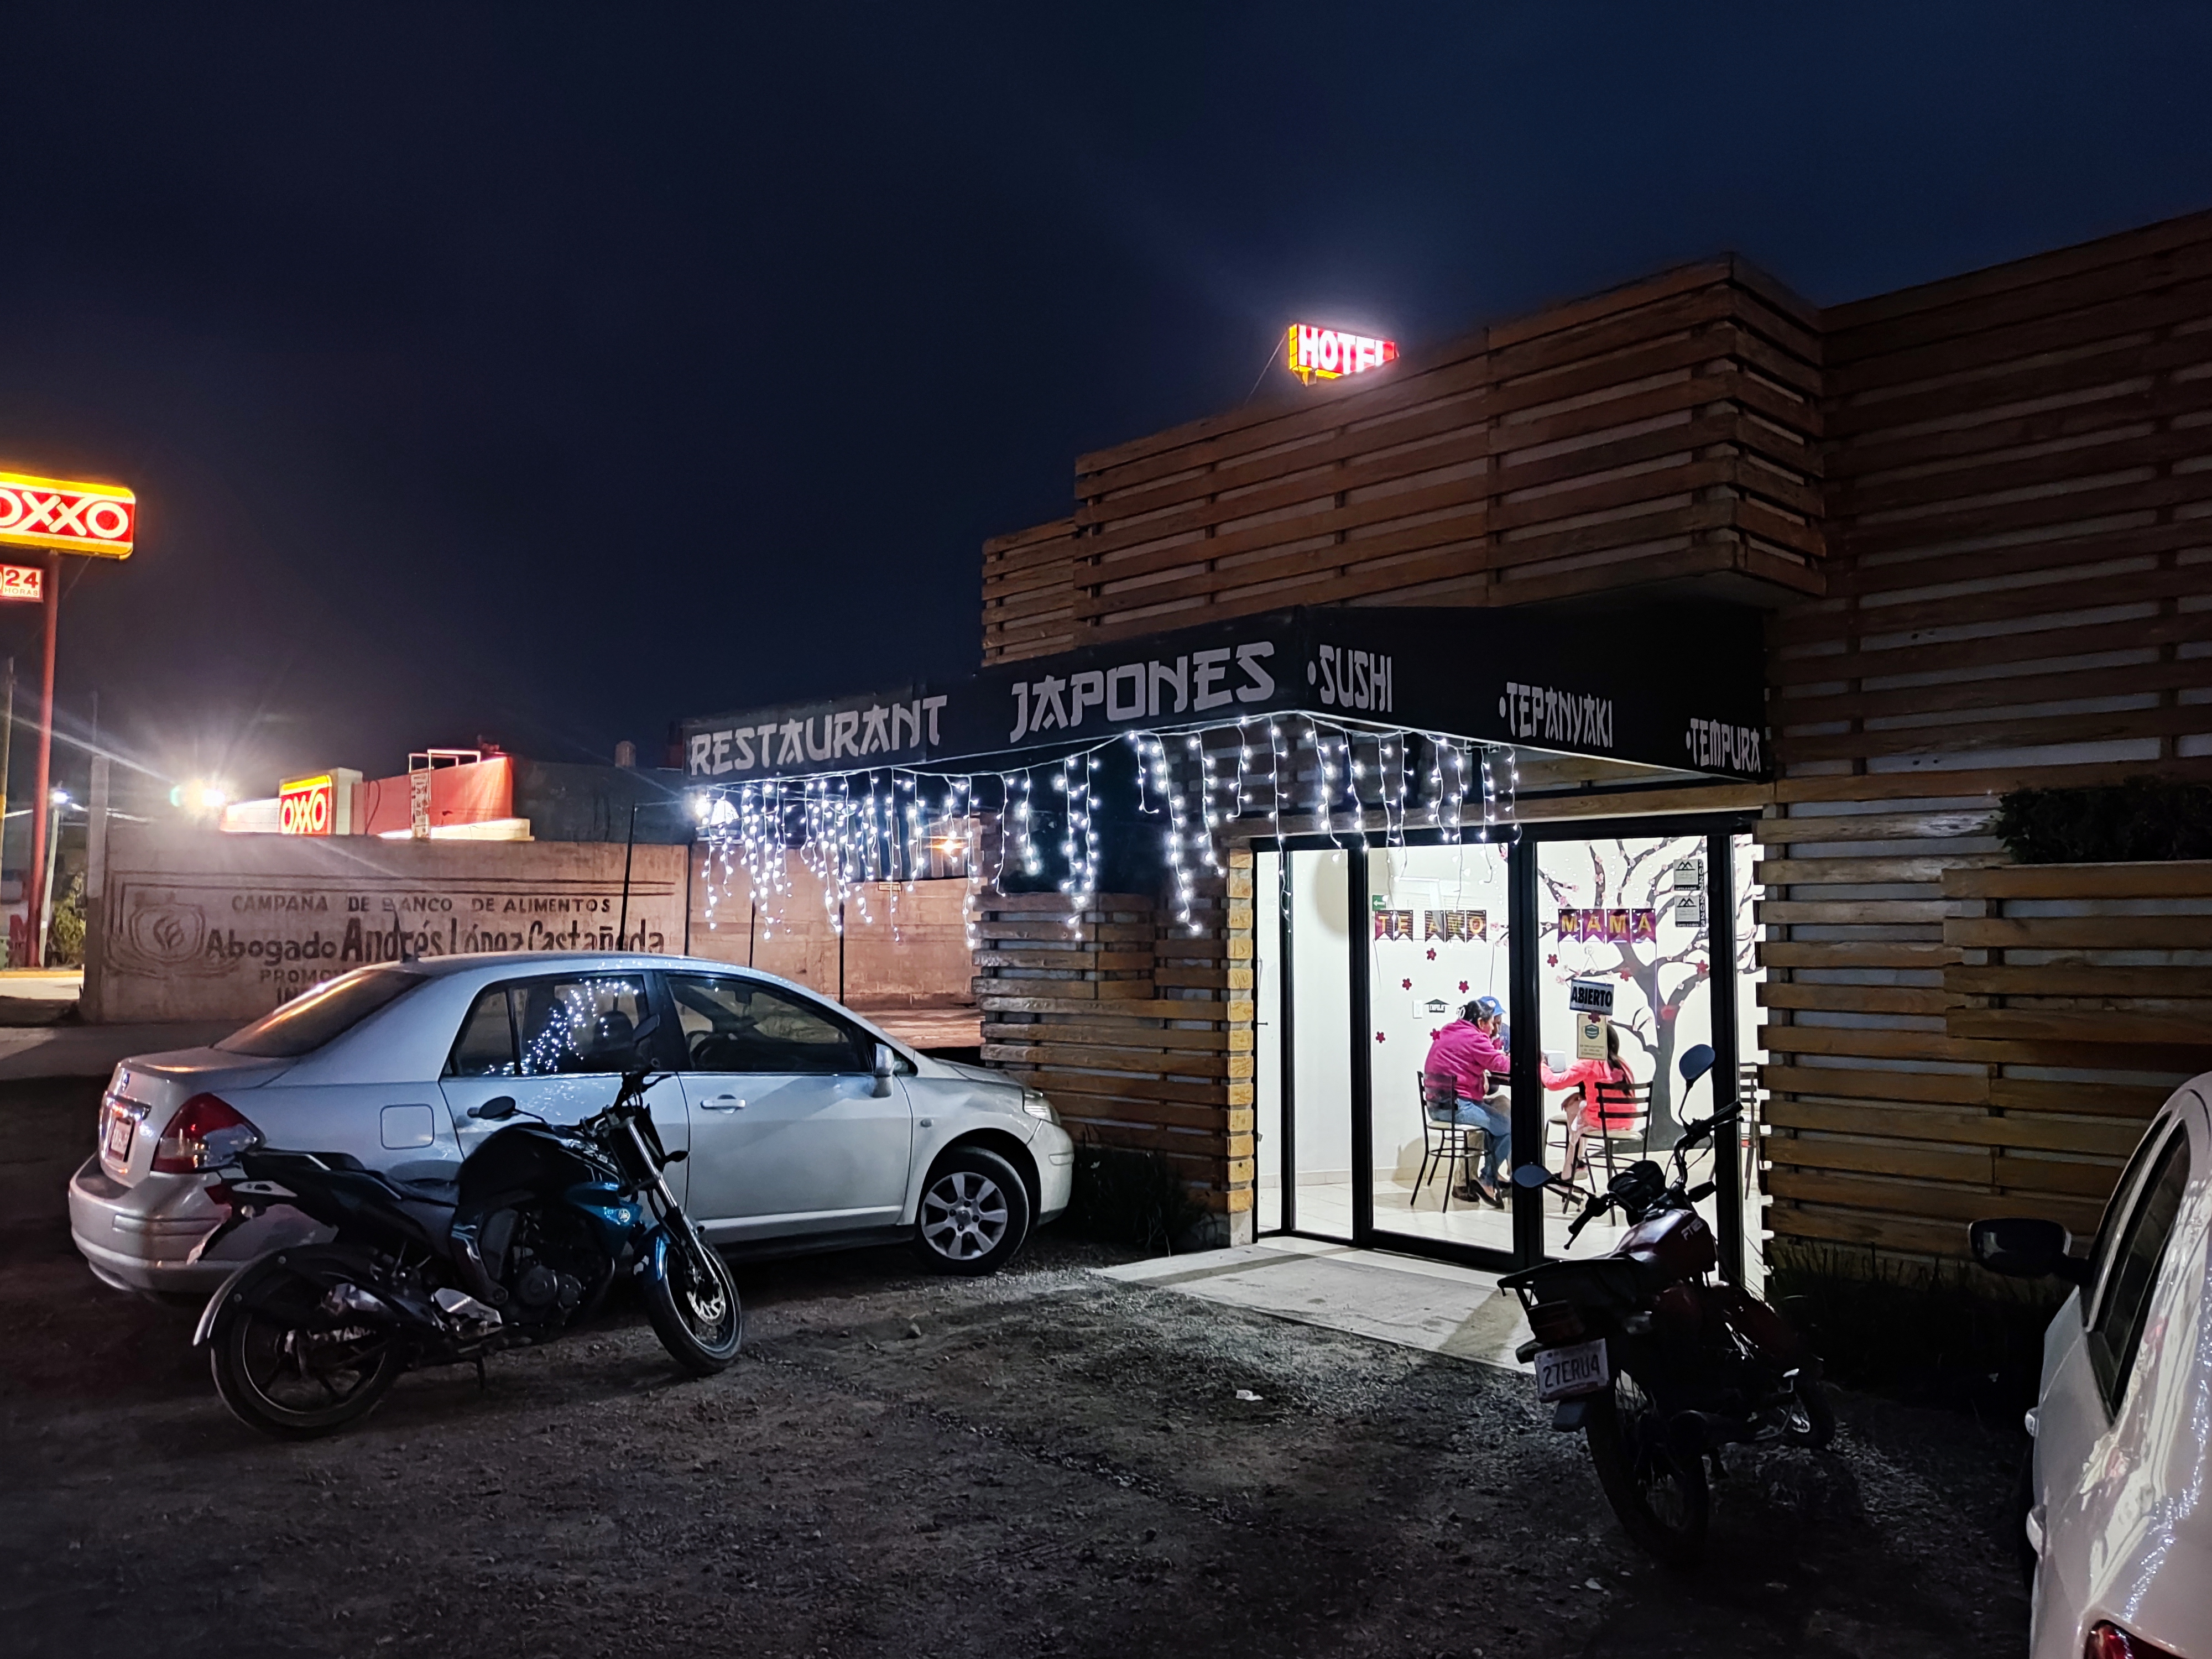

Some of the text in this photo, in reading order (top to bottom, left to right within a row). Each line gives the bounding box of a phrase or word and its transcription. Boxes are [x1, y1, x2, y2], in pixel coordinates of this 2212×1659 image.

[4, 587, 38, 596] HORAS
[6, 569, 38, 588] 24
[690, 641, 1275, 775] RESTAURANT JAPONES
[1319, 644, 1761, 773] SUSHI TEPANYAKI TEMPURA
[280, 791, 326, 834] OXXO
[348, 896, 370, 912] DE
[382, 896, 453, 912] BANCO
[472, 898, 495, 912] DE
[503, 898, 610, 913] ALIMENTOS
[1378, 915, 1409, 933] TE
[205, 928, 337, 966] Abogado
[1571, 986, 1613, 1007] ABIERTO
[1543, 1354, 1600, 1389] 27ERU4
